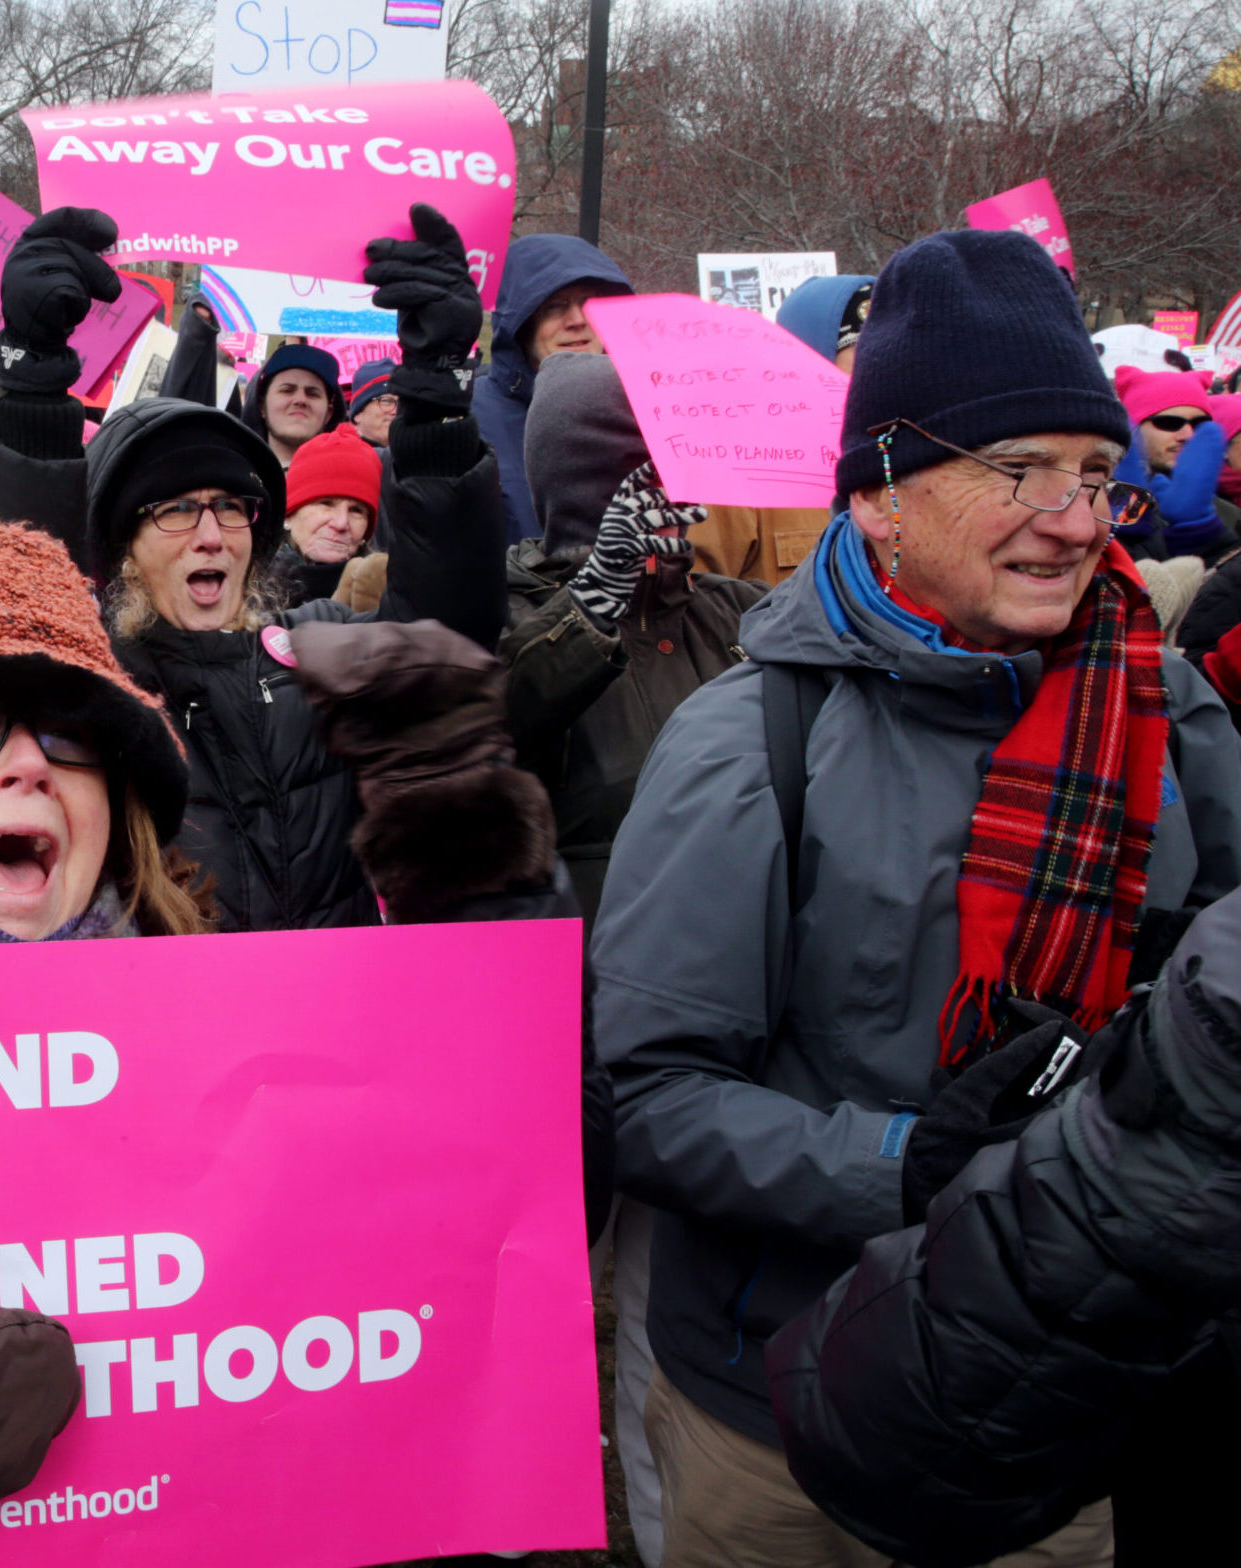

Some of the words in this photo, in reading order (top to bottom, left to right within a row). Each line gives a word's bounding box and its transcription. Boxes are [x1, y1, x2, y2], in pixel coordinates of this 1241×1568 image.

[230, 0, 379, 88] Stop
[41, 107, 213, 131] Don't
[218, 104, 369, 124] Take
[47, 135, 220, 176] Away
[234, 135, 351, 170] Our
[363, 137, 512, 189] Care.
[96, 232, 239, 257] andwithPP
[650, 366, 747, 387] PROTECT
[652, 402, 756, 421] PROTECT
[664, 434, 728, 460] FUND
[733, 444, 806, 461] PLANNED
